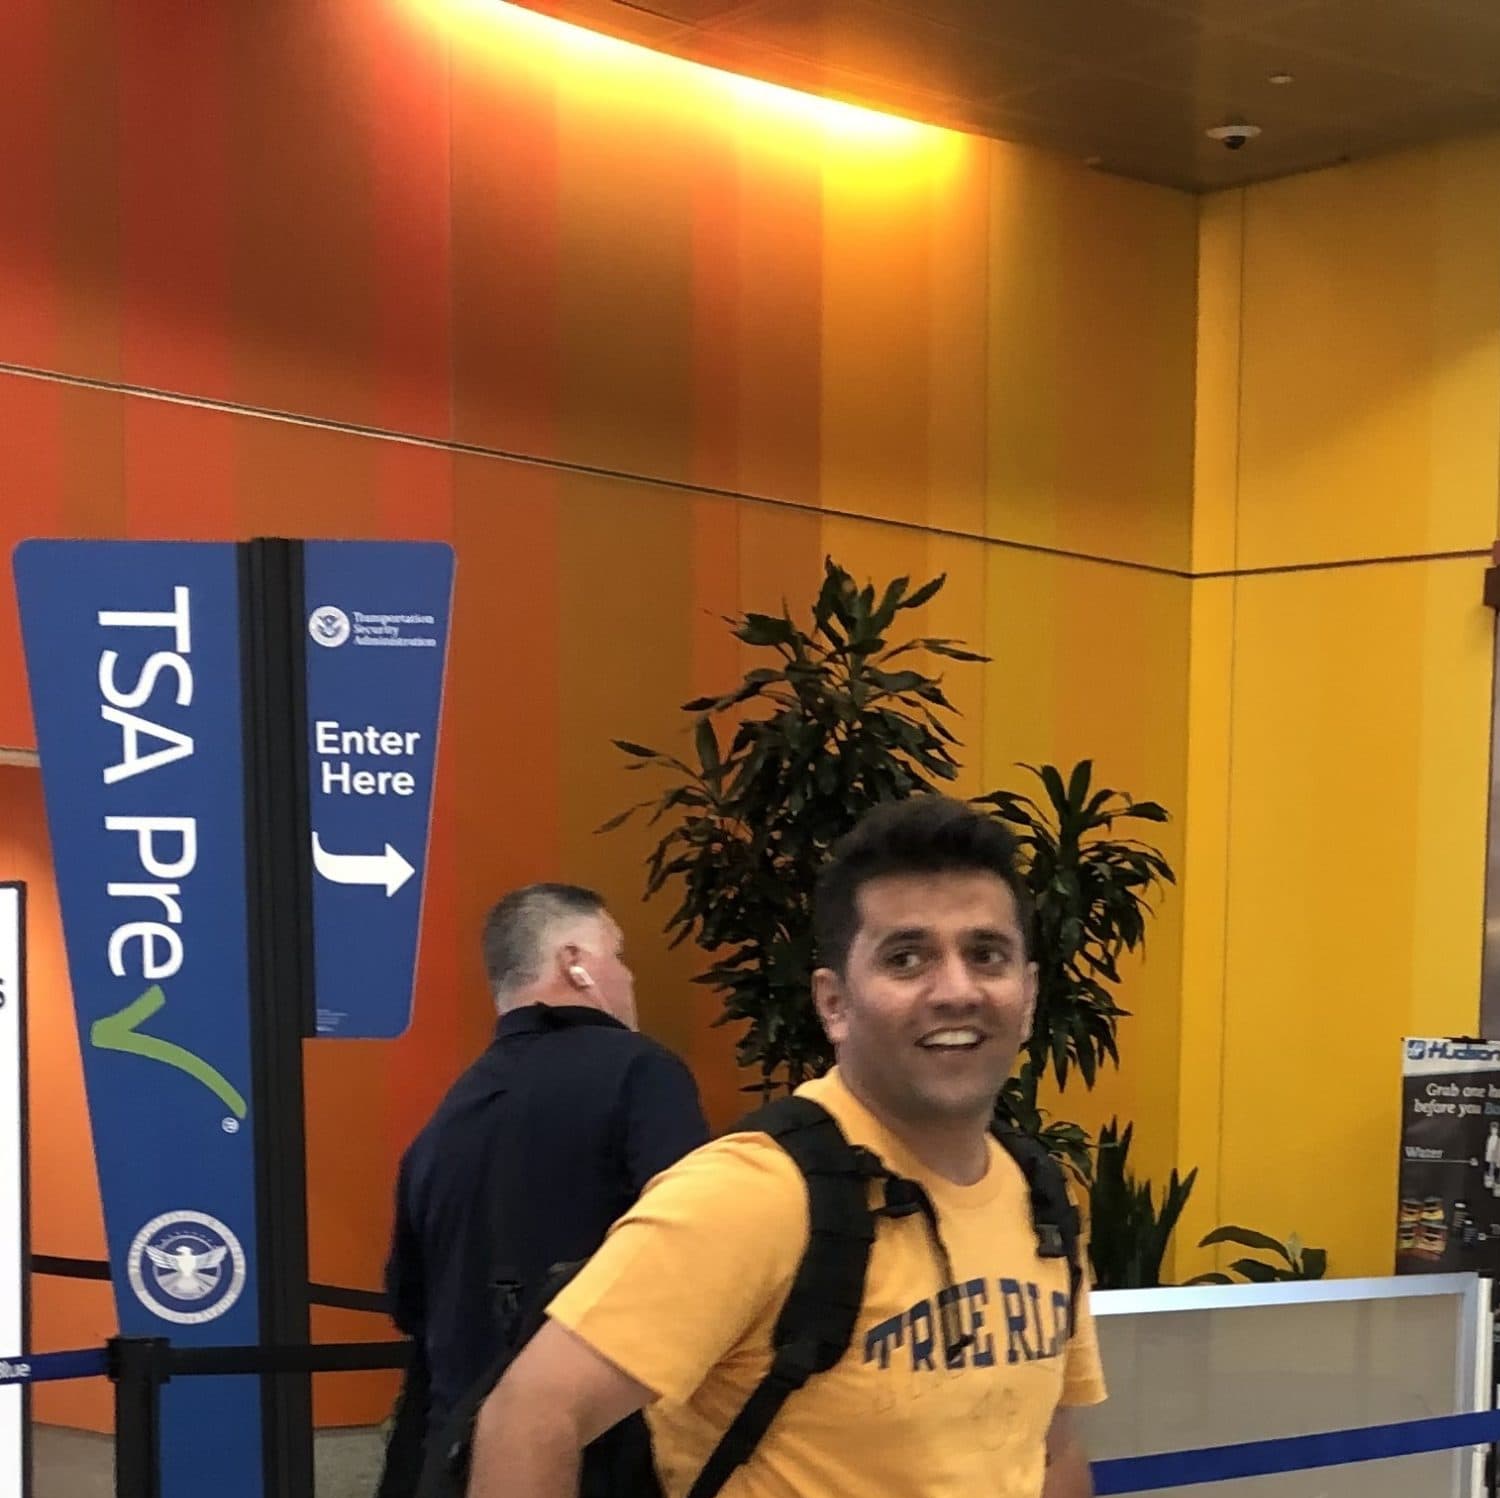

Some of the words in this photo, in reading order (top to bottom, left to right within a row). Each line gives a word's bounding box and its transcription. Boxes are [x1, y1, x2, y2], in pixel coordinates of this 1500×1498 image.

[98, 586, 194, 785] TSA
[315, 721, 420, 756] Enter
[321, 762, 415, 796] Here
[1426, 1083, 1460, 1097] Grab
[1414, 1098, 1456, 1116] before
[1457, 1103, 1481, 1117] you
